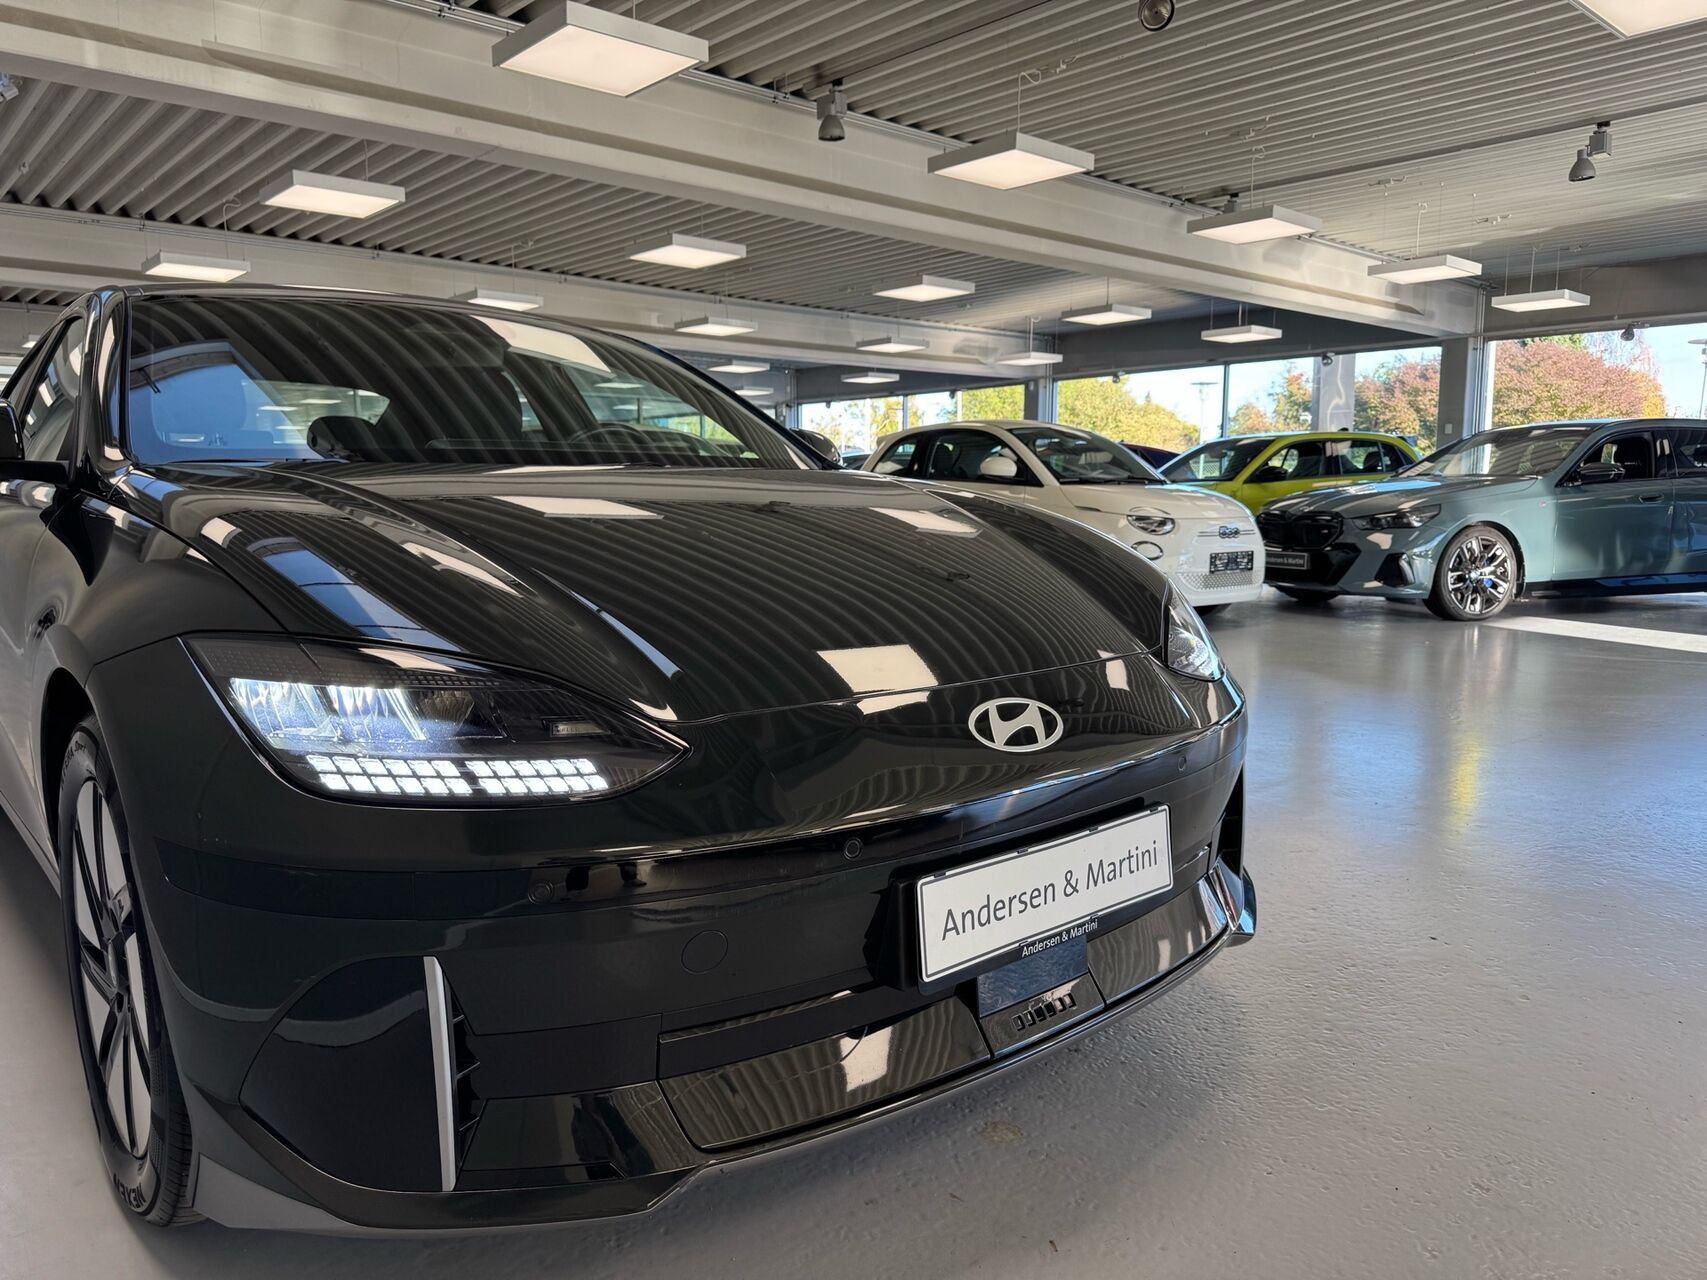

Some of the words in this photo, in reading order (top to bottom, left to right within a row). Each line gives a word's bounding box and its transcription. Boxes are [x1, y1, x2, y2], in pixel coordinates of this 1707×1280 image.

[942, 881, 1056, 941] Andersen
[1063, 869, 1080, 898] &
[1086, 840, 1158, 890] Martini
[1021, 936, 1061, 958] Andersen
[1062, 931, 1069, 942] &
[1070, 919, 1098, 939] Martini
